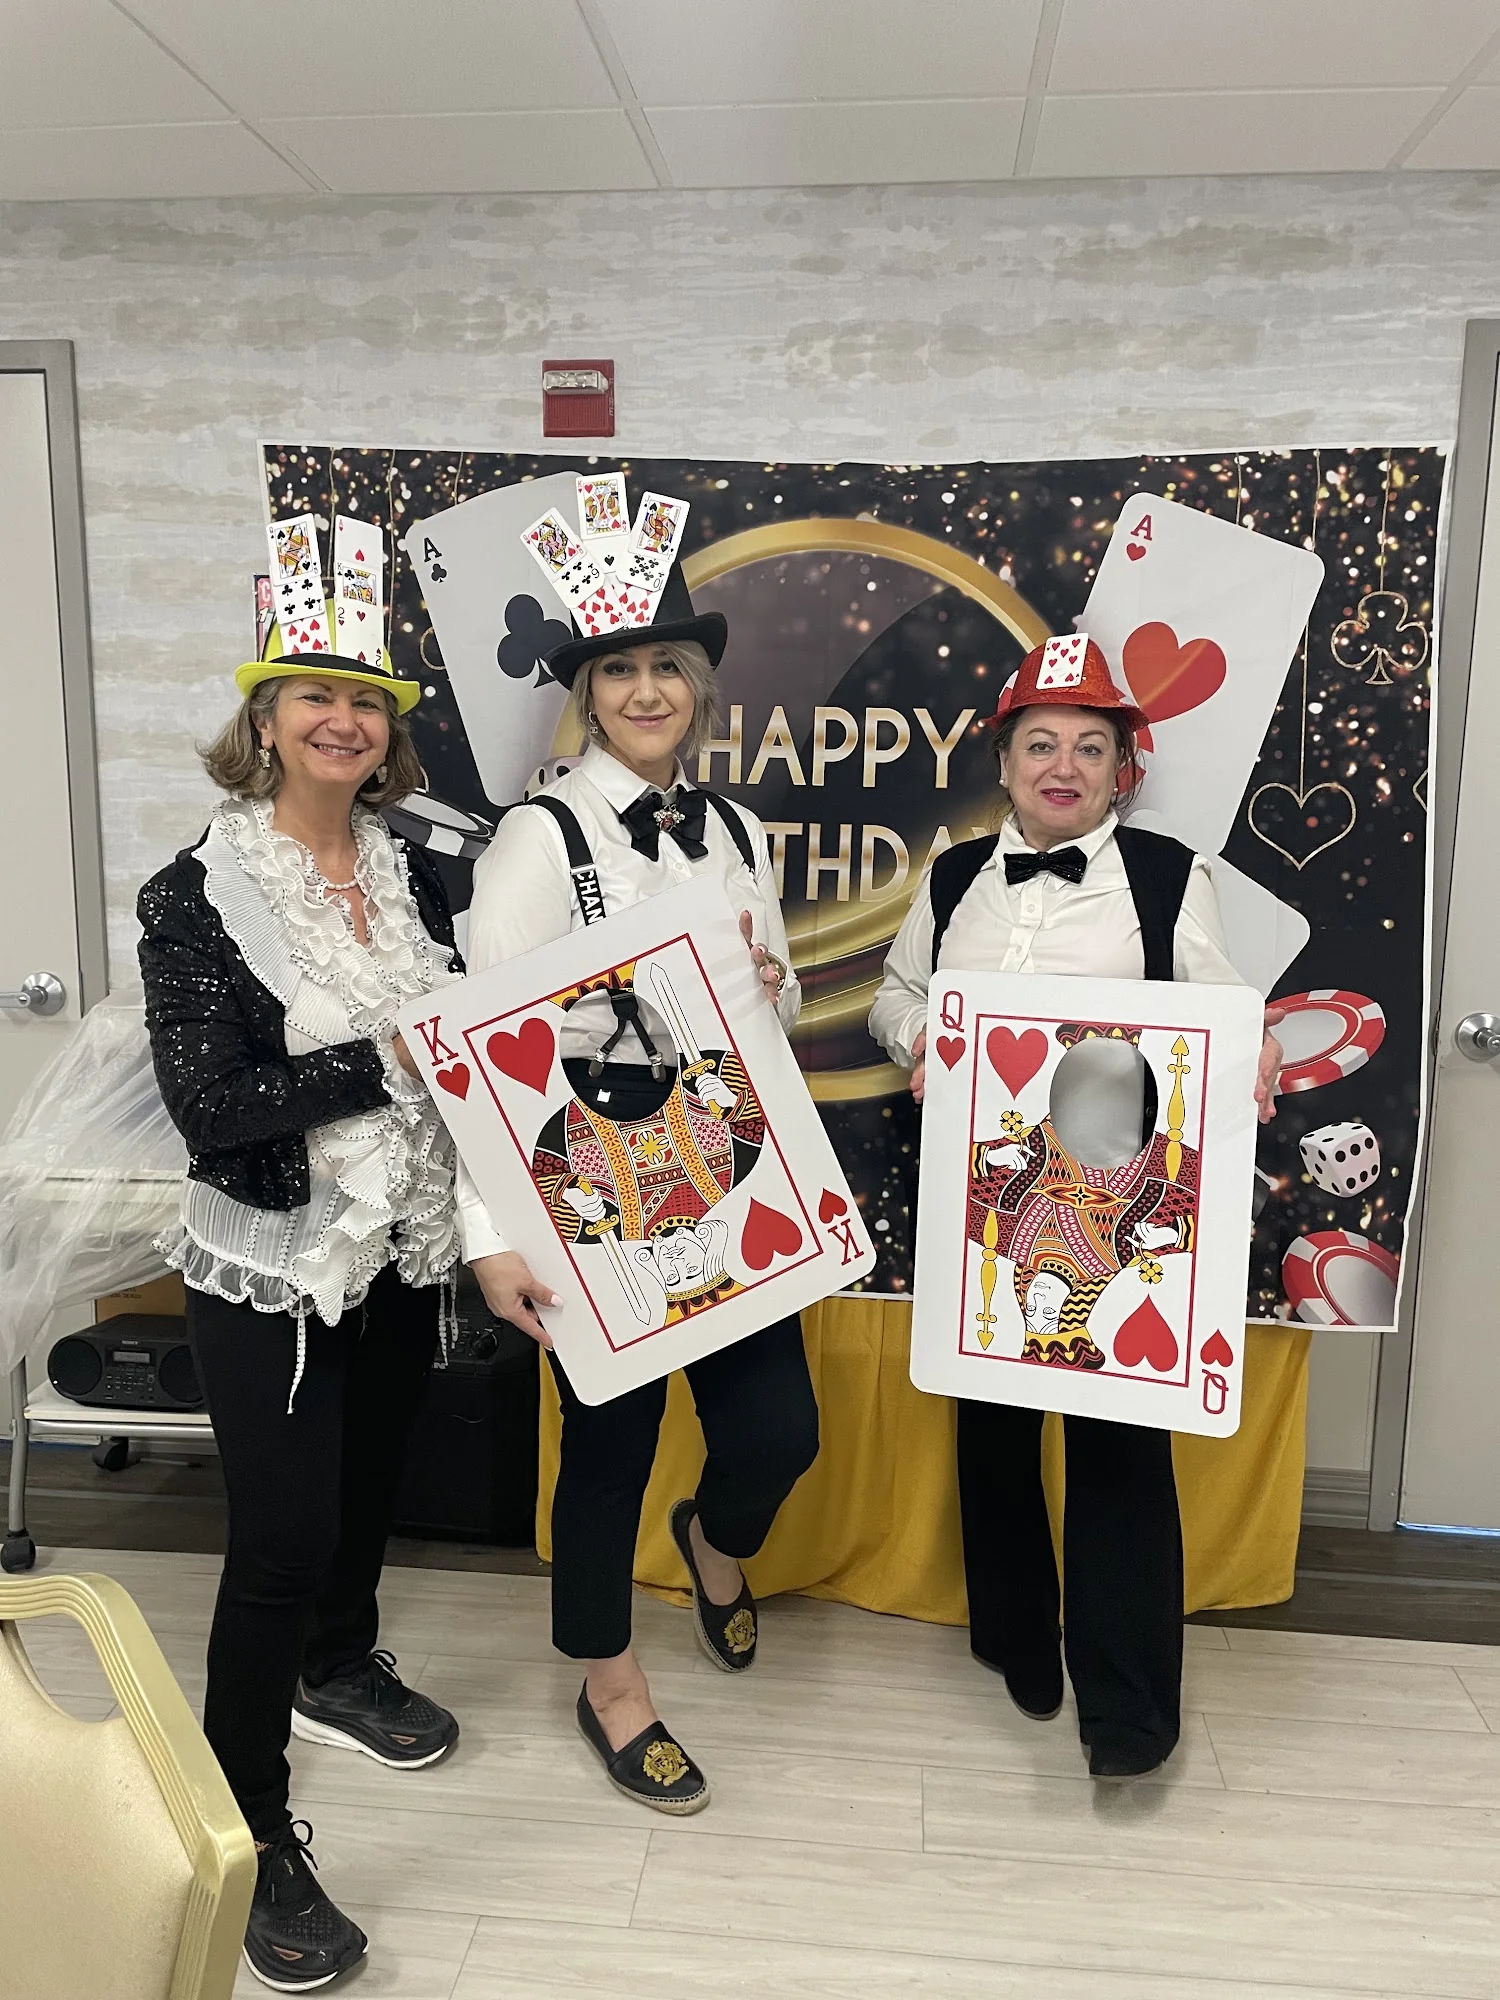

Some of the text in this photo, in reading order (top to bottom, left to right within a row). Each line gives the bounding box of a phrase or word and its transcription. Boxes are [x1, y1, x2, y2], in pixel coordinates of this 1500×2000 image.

[1130, 514, 1153, 541] A
[423, 537, 443, 563] A
[337, 606, 345, 619] 2
[375, 654, 382, 667] 2
[697, 704, 977, 789] HAPPY
[940, 990, 965, 1033] Q
[413, 1015, 459, 1067] K
[827, 1218, 864, 1266] K
[1201, 1368, 1229, 1415] Q
